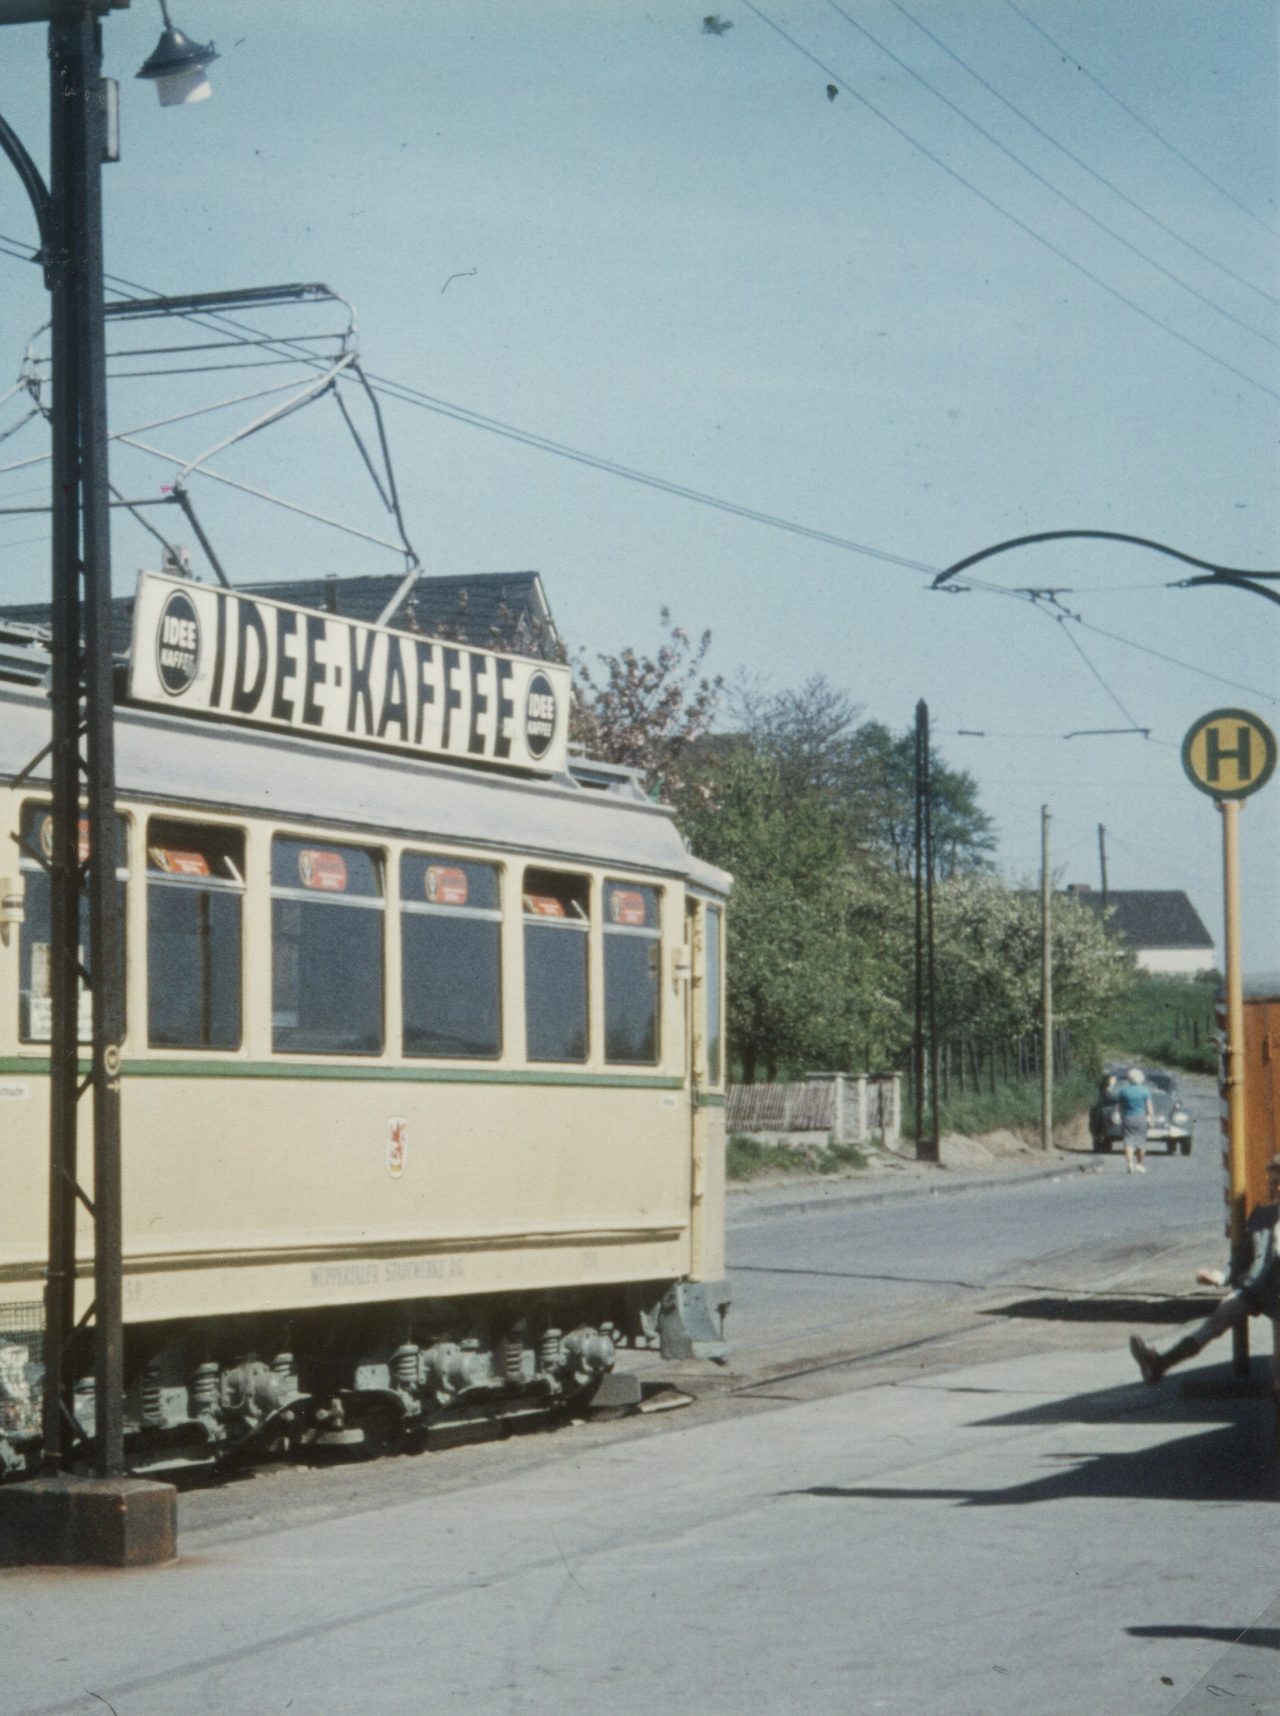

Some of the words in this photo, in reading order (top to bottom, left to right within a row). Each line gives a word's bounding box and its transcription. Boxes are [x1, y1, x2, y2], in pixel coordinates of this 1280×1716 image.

[162, 615, 197, 650] IDEE
[209, 593, 514, 758] IDEE-KAFFEE
[528, 692, 555, 720] IDEE
[1205, 727, 1252, 782] H
